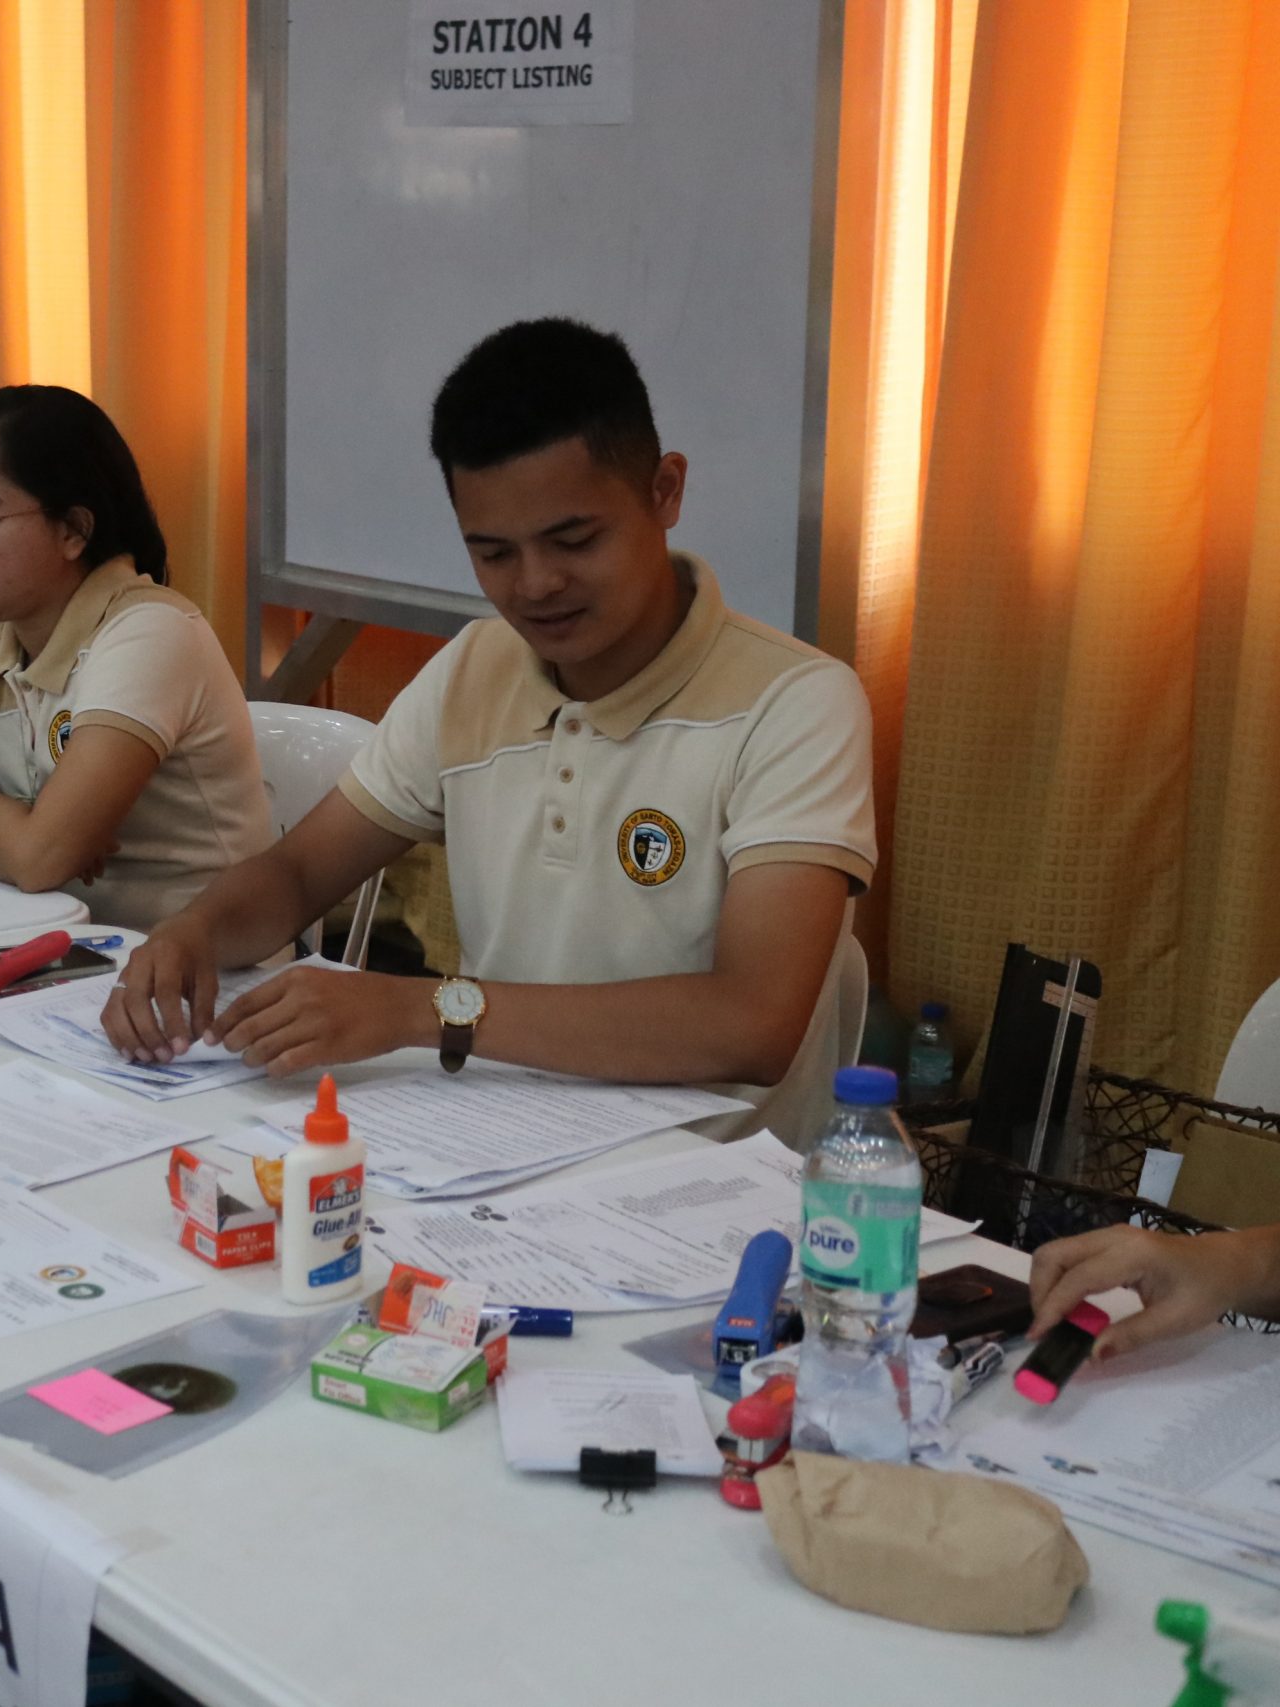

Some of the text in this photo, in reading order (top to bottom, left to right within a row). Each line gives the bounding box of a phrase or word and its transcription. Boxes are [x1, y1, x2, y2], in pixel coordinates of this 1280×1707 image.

[432, 12, 593, 54] STATION 4
[430, 64, 593, 90] SUBJECT LISTING
[809, 1230, 855, 1255] pure
